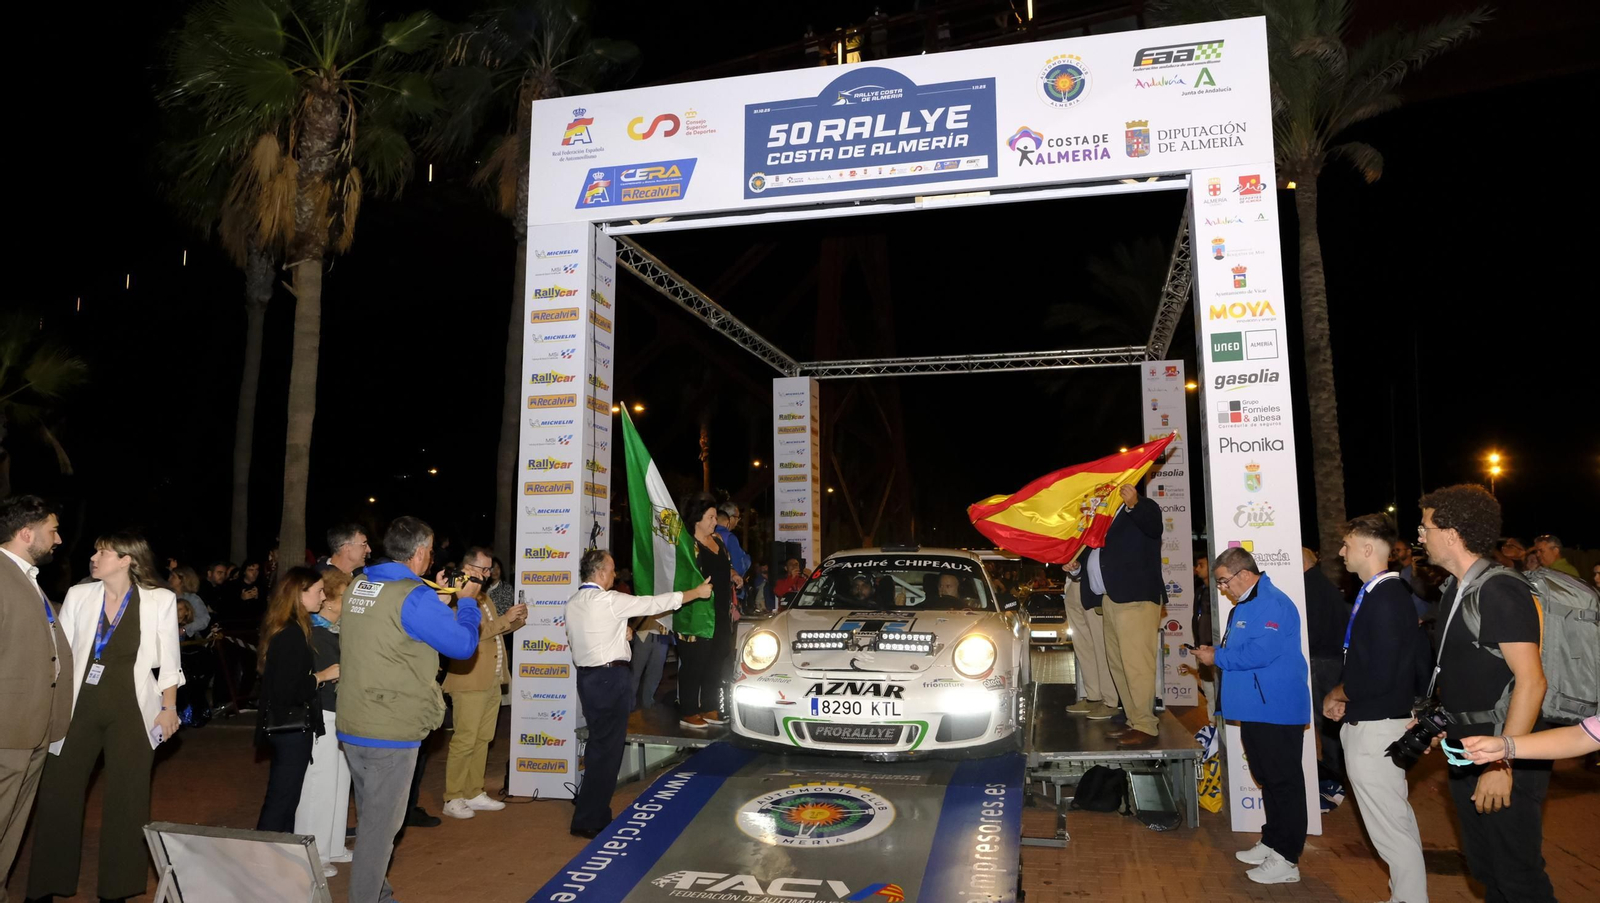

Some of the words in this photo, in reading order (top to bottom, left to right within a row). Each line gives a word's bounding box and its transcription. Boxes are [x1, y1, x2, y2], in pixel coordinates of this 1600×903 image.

[1135, 74, 1186, 89] Andalucía
[854, 91, 879, 99] RALLYE
[767, 121, 812, 148] 50
[816, 104, 972, 143] RALLYE
[1158, 121, 1247, 141] DIPUTACIÓN
[1048, 135, 1090, 148] COSTA
[1093, 134, 1109, 144] DE
[1158, 142, 1177, 153] DE
[1181, 135, 1244, 152] ALMERÍA
[766, 147, 834, 165] COSTA
[838, 145, 867, 159] DE
[870, 133, 970, 156] ALMERÍA
[1035, 144, 1111, 166] ALMERÍA
[620, 165, 682, 183] CERA
[632, 186, 670, 199] Recalvi
[534, 288, 578, 299] Rallycar
[541, 310, 570, 321] Recalvi
[1210, 300, 1276, 320] MOYA
[1214, 341, 1240, 352] UNED
[532, 372, 576, 383] Rallycar
[1214, 369, 1280, 389] gasolia
[537, 396, 567, 406] Recalvi
[1243, 405, 1281, 414] Fornieles
[1219, 437, 1284, 453] Phonika
[528, 459, 573, 470] Rallycar
[533, 484, 564, 493] Recalvi
[525, 548, 570, 559] Rallycar
[1254, 549, 1291, 561] arcía
[842, 559, 888, 569] André
[895, 560, 972, 572] CHIPEAUX
[531, 573, 562, 583] Recalvi
[348, 598, 376, 607] FOTO/TV
[350, 606, 365, 614] 2025
[523, 640, 568, 651] Rallycar
[529, 666, 560, 676] Recalvi
[805, 682, 904, 699] AZNAR
[822, 700, 862, 715] 8290
[872, 702, 901, 716] KTL
[816, 727, 895, 738] PRORALLYE
[520, 733, 566, 746] Rallycar
[527, 760, 557, 770] Recalvi
[757, 787, 855, 805] AUTOMOVIL
[861, 794, 888, 811] CLUB
[782, 838, 845, 846] MERIA
[669, 889, 741, 901] FEDERACIÓN
